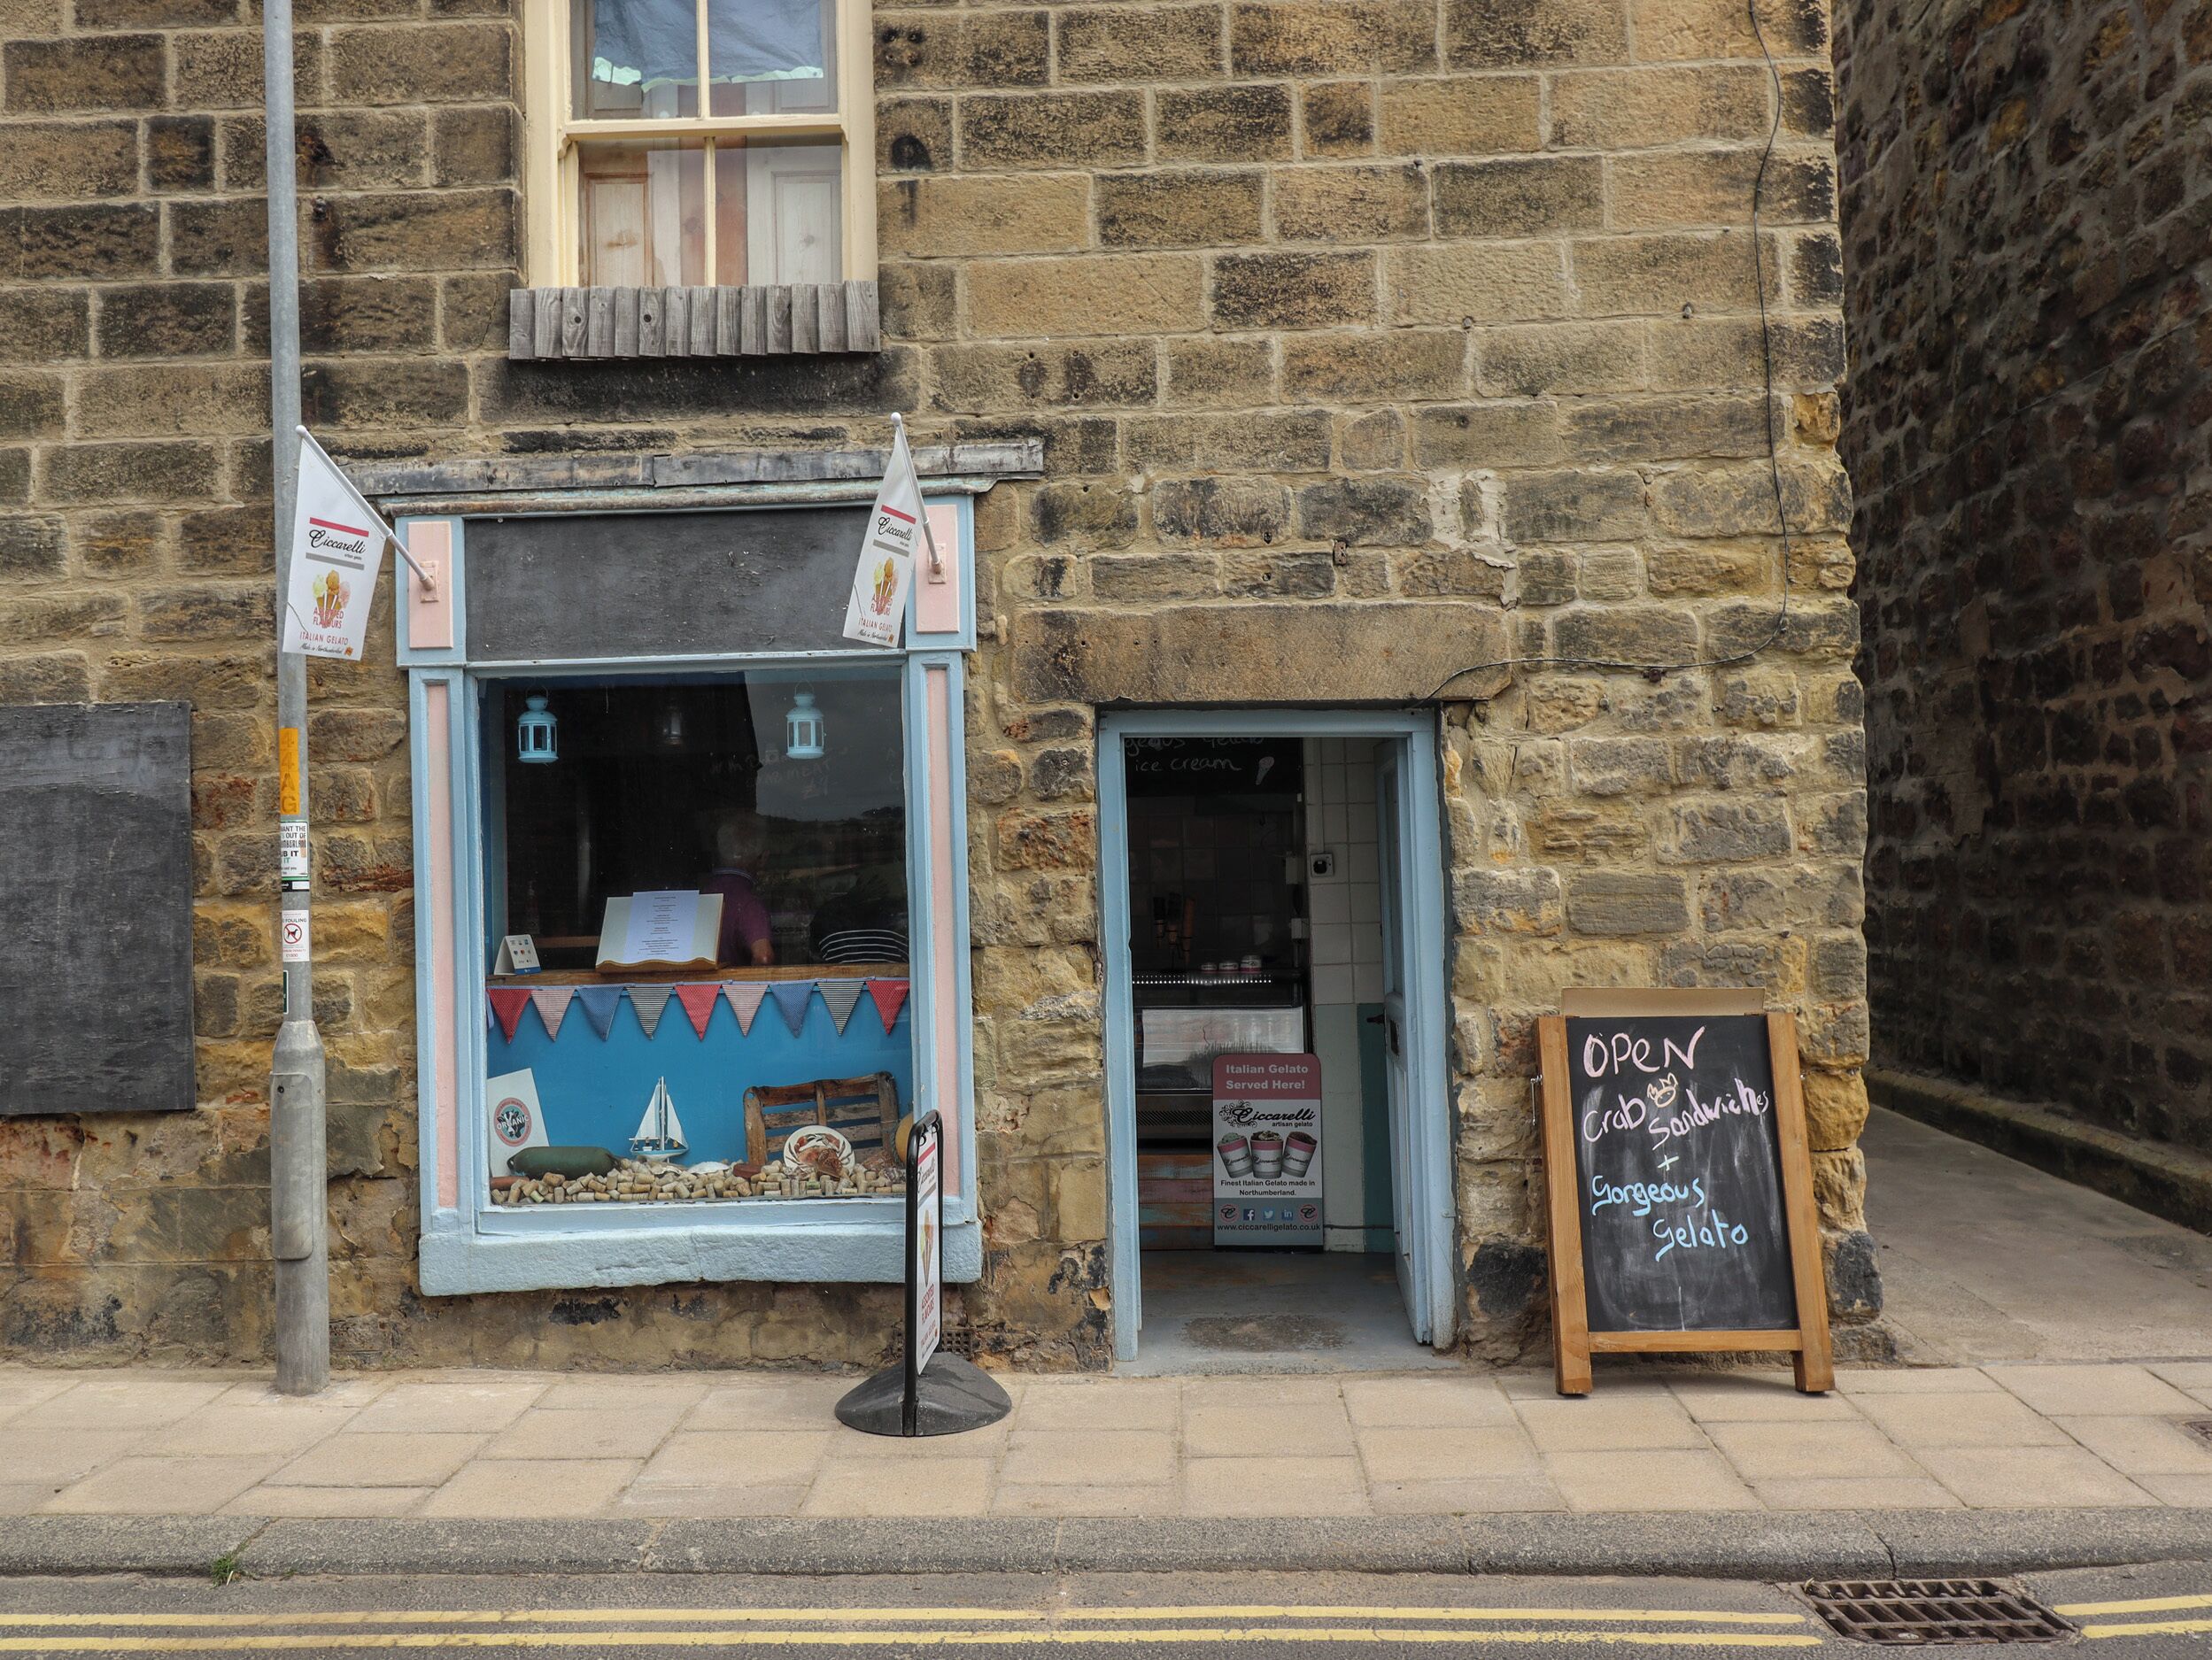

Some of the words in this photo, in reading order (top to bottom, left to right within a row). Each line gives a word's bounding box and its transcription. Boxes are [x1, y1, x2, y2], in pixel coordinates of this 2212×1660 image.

[878, 516, 914, 541] Ciccarelli
[309, 529, 367, 553] Ciccarelli
[299, 631, 324, 642] ITALIAN
[326, 635, 349, 645] GELATO
[1133, 759, 1164, 772] ice
[1170, 757, 1243, 772] cream
[1226, 1064, 1265, 1074] Italian
[1268, 1064, 1309, 1074] Gelato
[1226, 1080, 1268, 1090] Served
[1272, 1080, 1305, 1090] Here!
[1231, 1107, 1316, 1124] Ciccarelli
